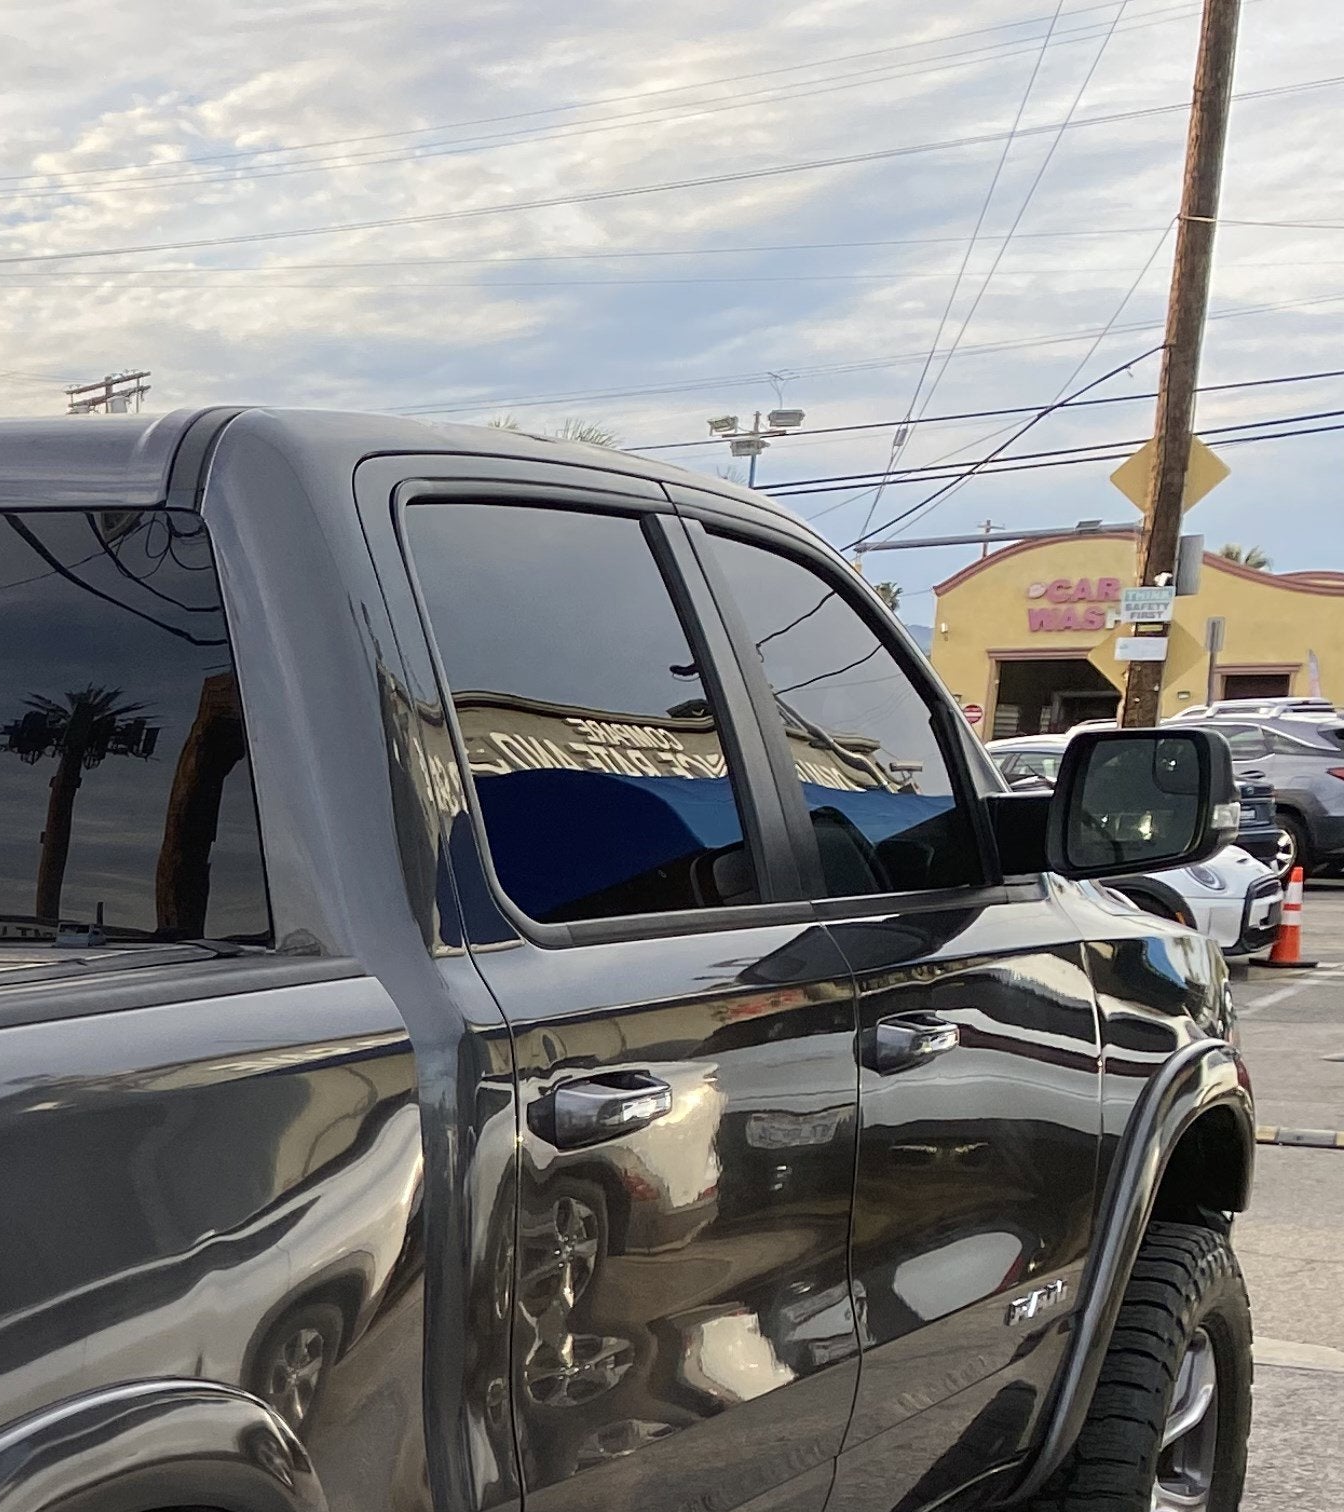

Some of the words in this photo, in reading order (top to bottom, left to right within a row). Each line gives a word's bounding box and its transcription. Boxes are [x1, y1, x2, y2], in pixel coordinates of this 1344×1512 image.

[1046, 577, 1121, 604] CAR
[1124, 602, 1170, 612] SAFETY
[1129, 611, 1164, 619] FIRST
